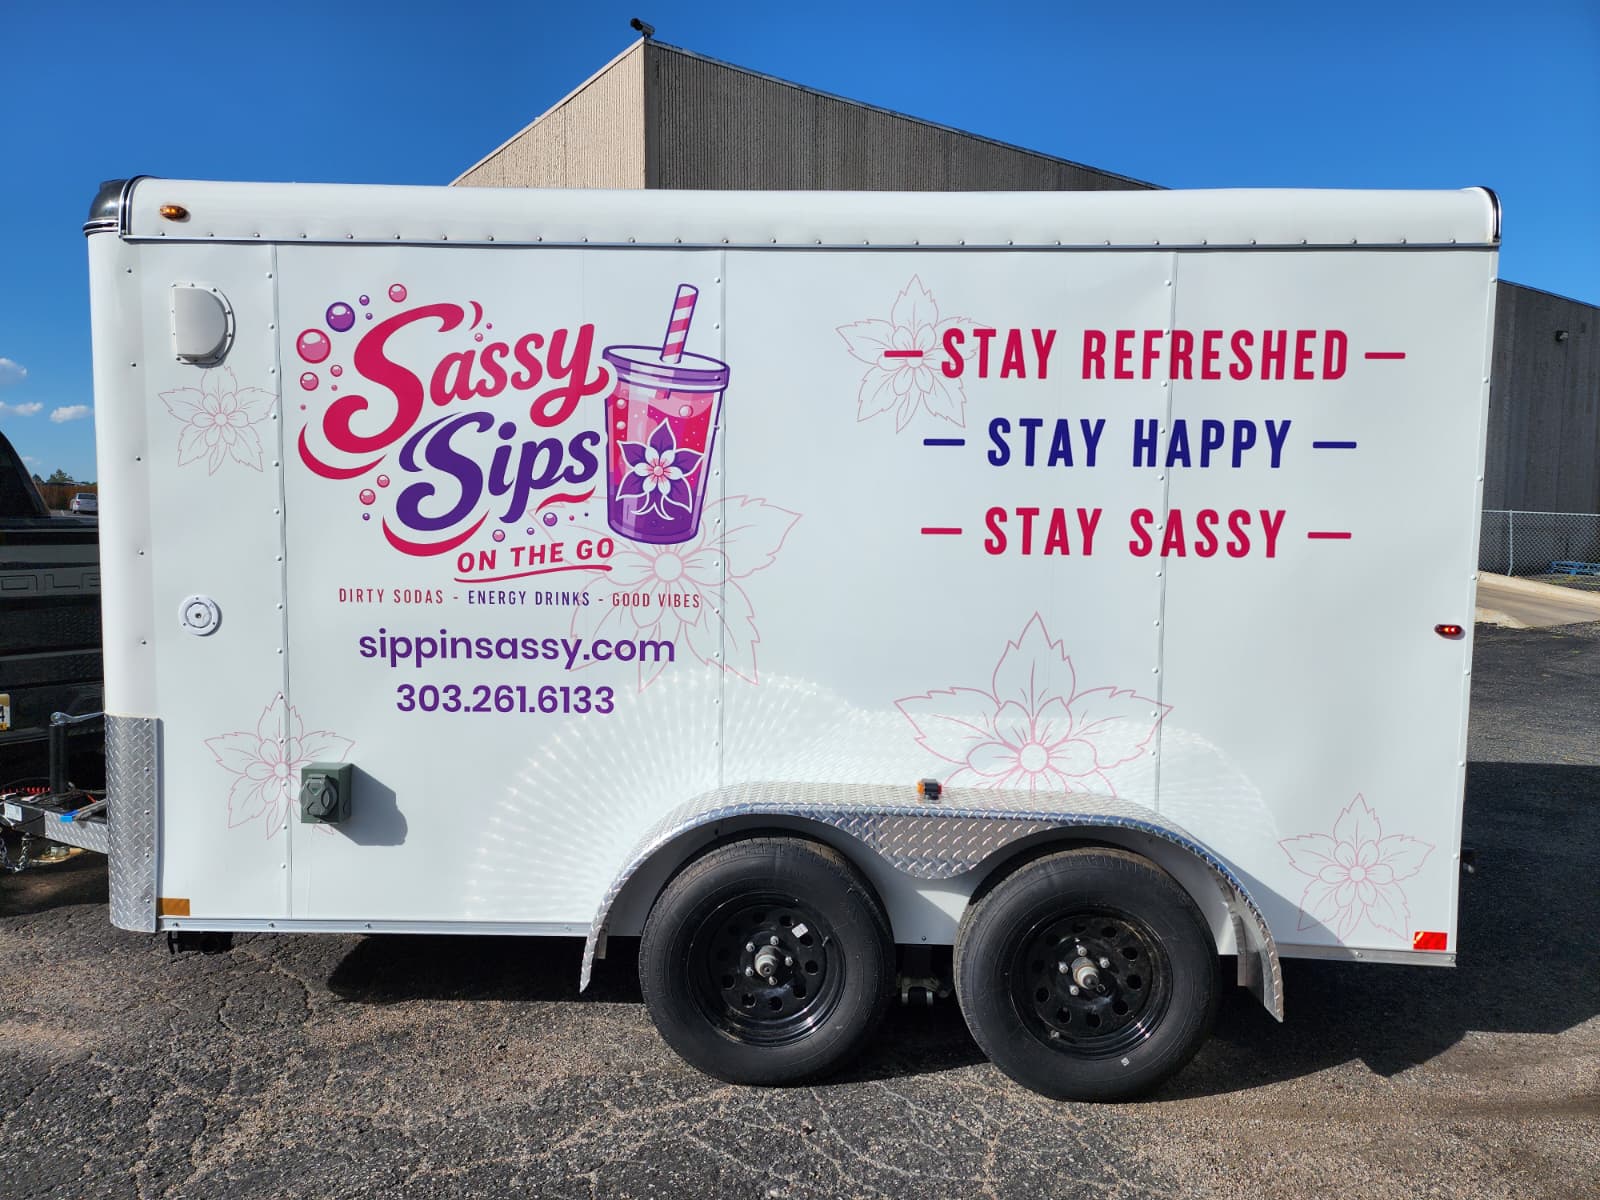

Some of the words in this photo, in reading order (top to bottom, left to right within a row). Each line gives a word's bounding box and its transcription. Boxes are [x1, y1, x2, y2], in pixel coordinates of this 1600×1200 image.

[322, 303, 610, 454] Sassy
[941, 327, 1057, 380] STAY
[1082, 328, 1348, 381] REFRESHED
[987, 417, 1106, 467] STAY
[1132, 418, 1292, 469] HAPPY
[396, 410, 601, 531] Sips
[456, 550, 498, 574] ON
[510, 542, 564, 567] THE
[576, 537, 615, 560] GO
[984, 506, 1103, 556] STAY
[1128, 507, 1286, 559] SASSY
[339, 588, 384, 603] DIRTY
[393, 589, 443, 604] SODAS
[468, 589, 527, 605] ENERGY
[535, 590, 590, 606] DRINKS
[612, 592, 651, 607] GOOD
[658, 593, 700, 609] VIBES
[359, 627, 675, 670] sippinsassy.com
[396, 683, 615, 714] 303.261.6133
